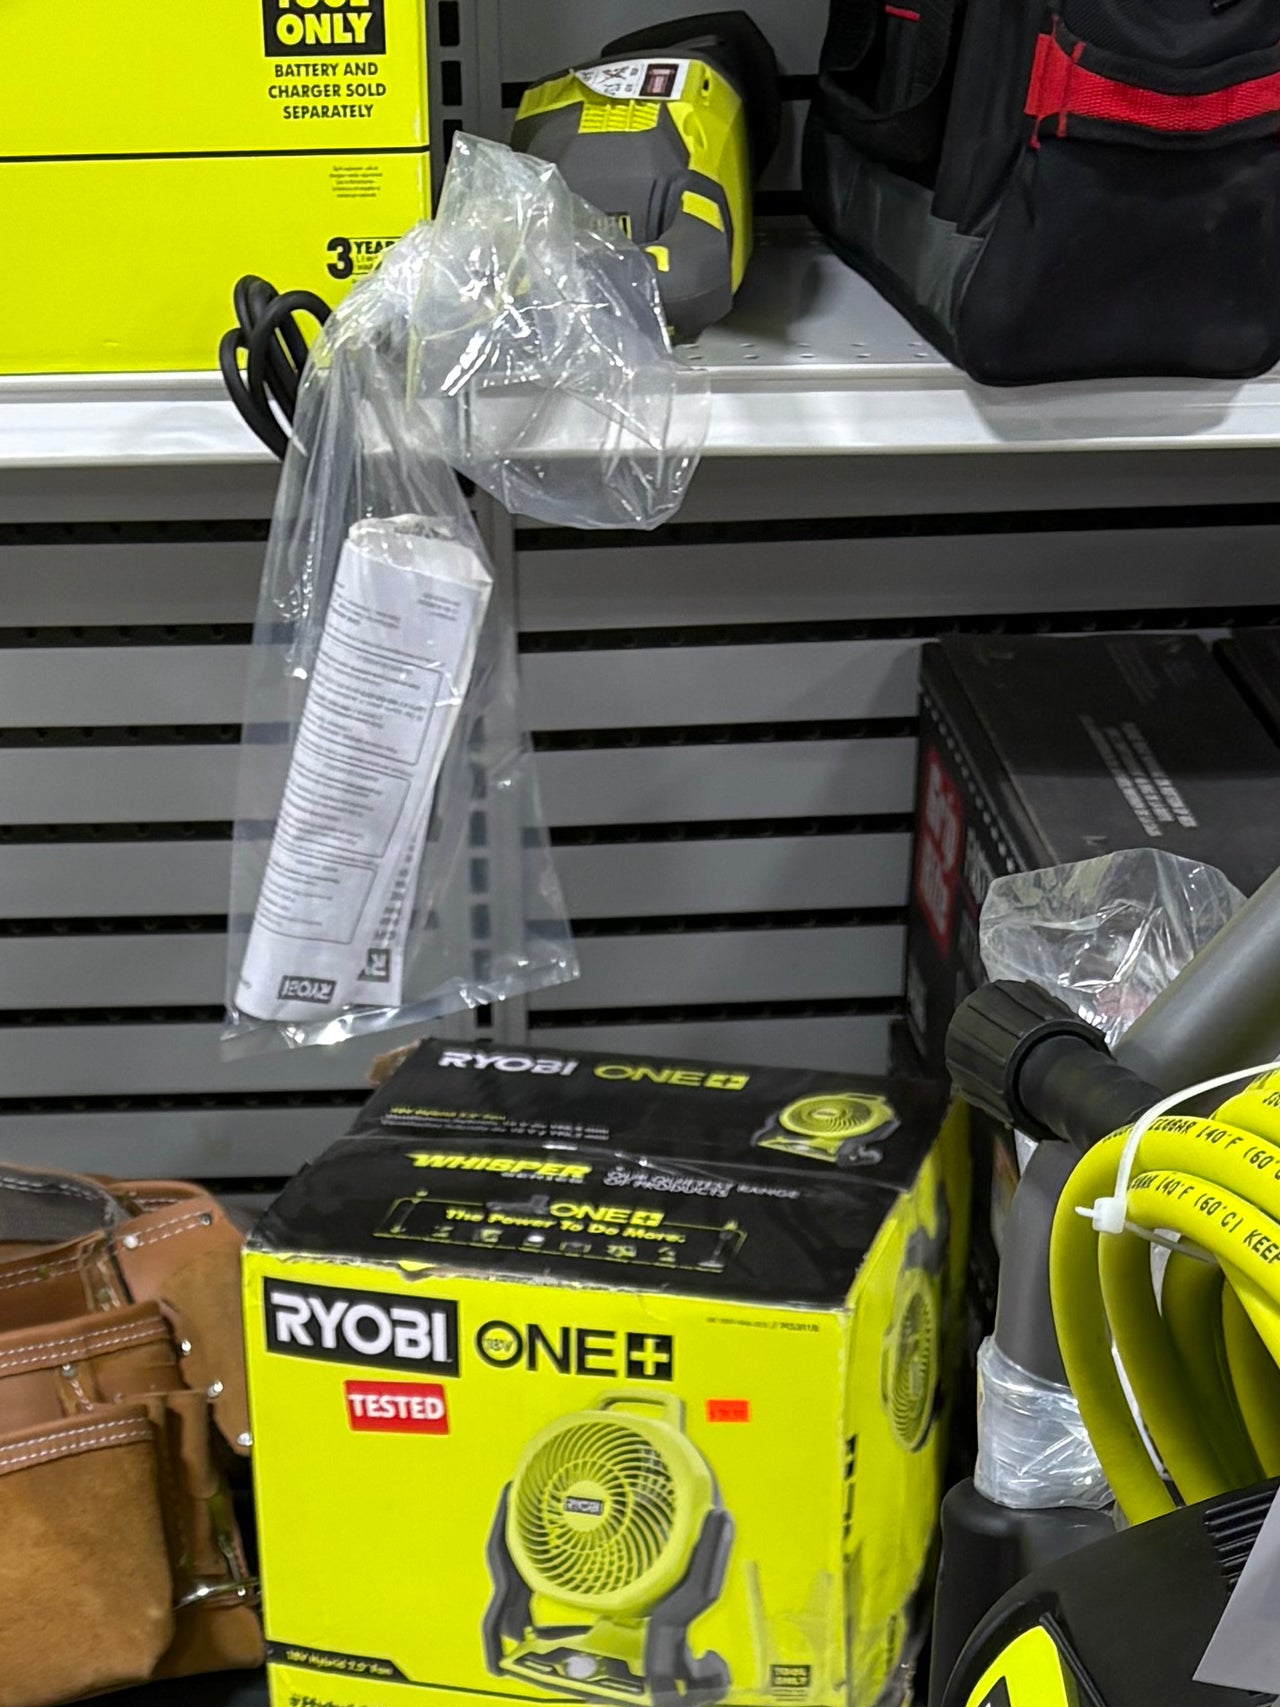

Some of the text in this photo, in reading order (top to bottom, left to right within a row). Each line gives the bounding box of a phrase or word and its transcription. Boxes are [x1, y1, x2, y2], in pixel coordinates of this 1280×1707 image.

[276, 13, 372, 46] ONLY
[274, 62, 379, 78] BATTERY AND
[268, 83, 387, 99] CHARGER SOLD
[283, 104, 374, 120] SEPARATELY
[326, 236, 353, 280] 3
[438, 1050, 579, 1077] RYOBI
[405, 1152, 593, 1181] WHISPER
[446, 1208, 619, 1237] The Power To Do
[270, 1291, 452, 1363] RYOBI
[348, 1394, 445, 1421] TESTED
